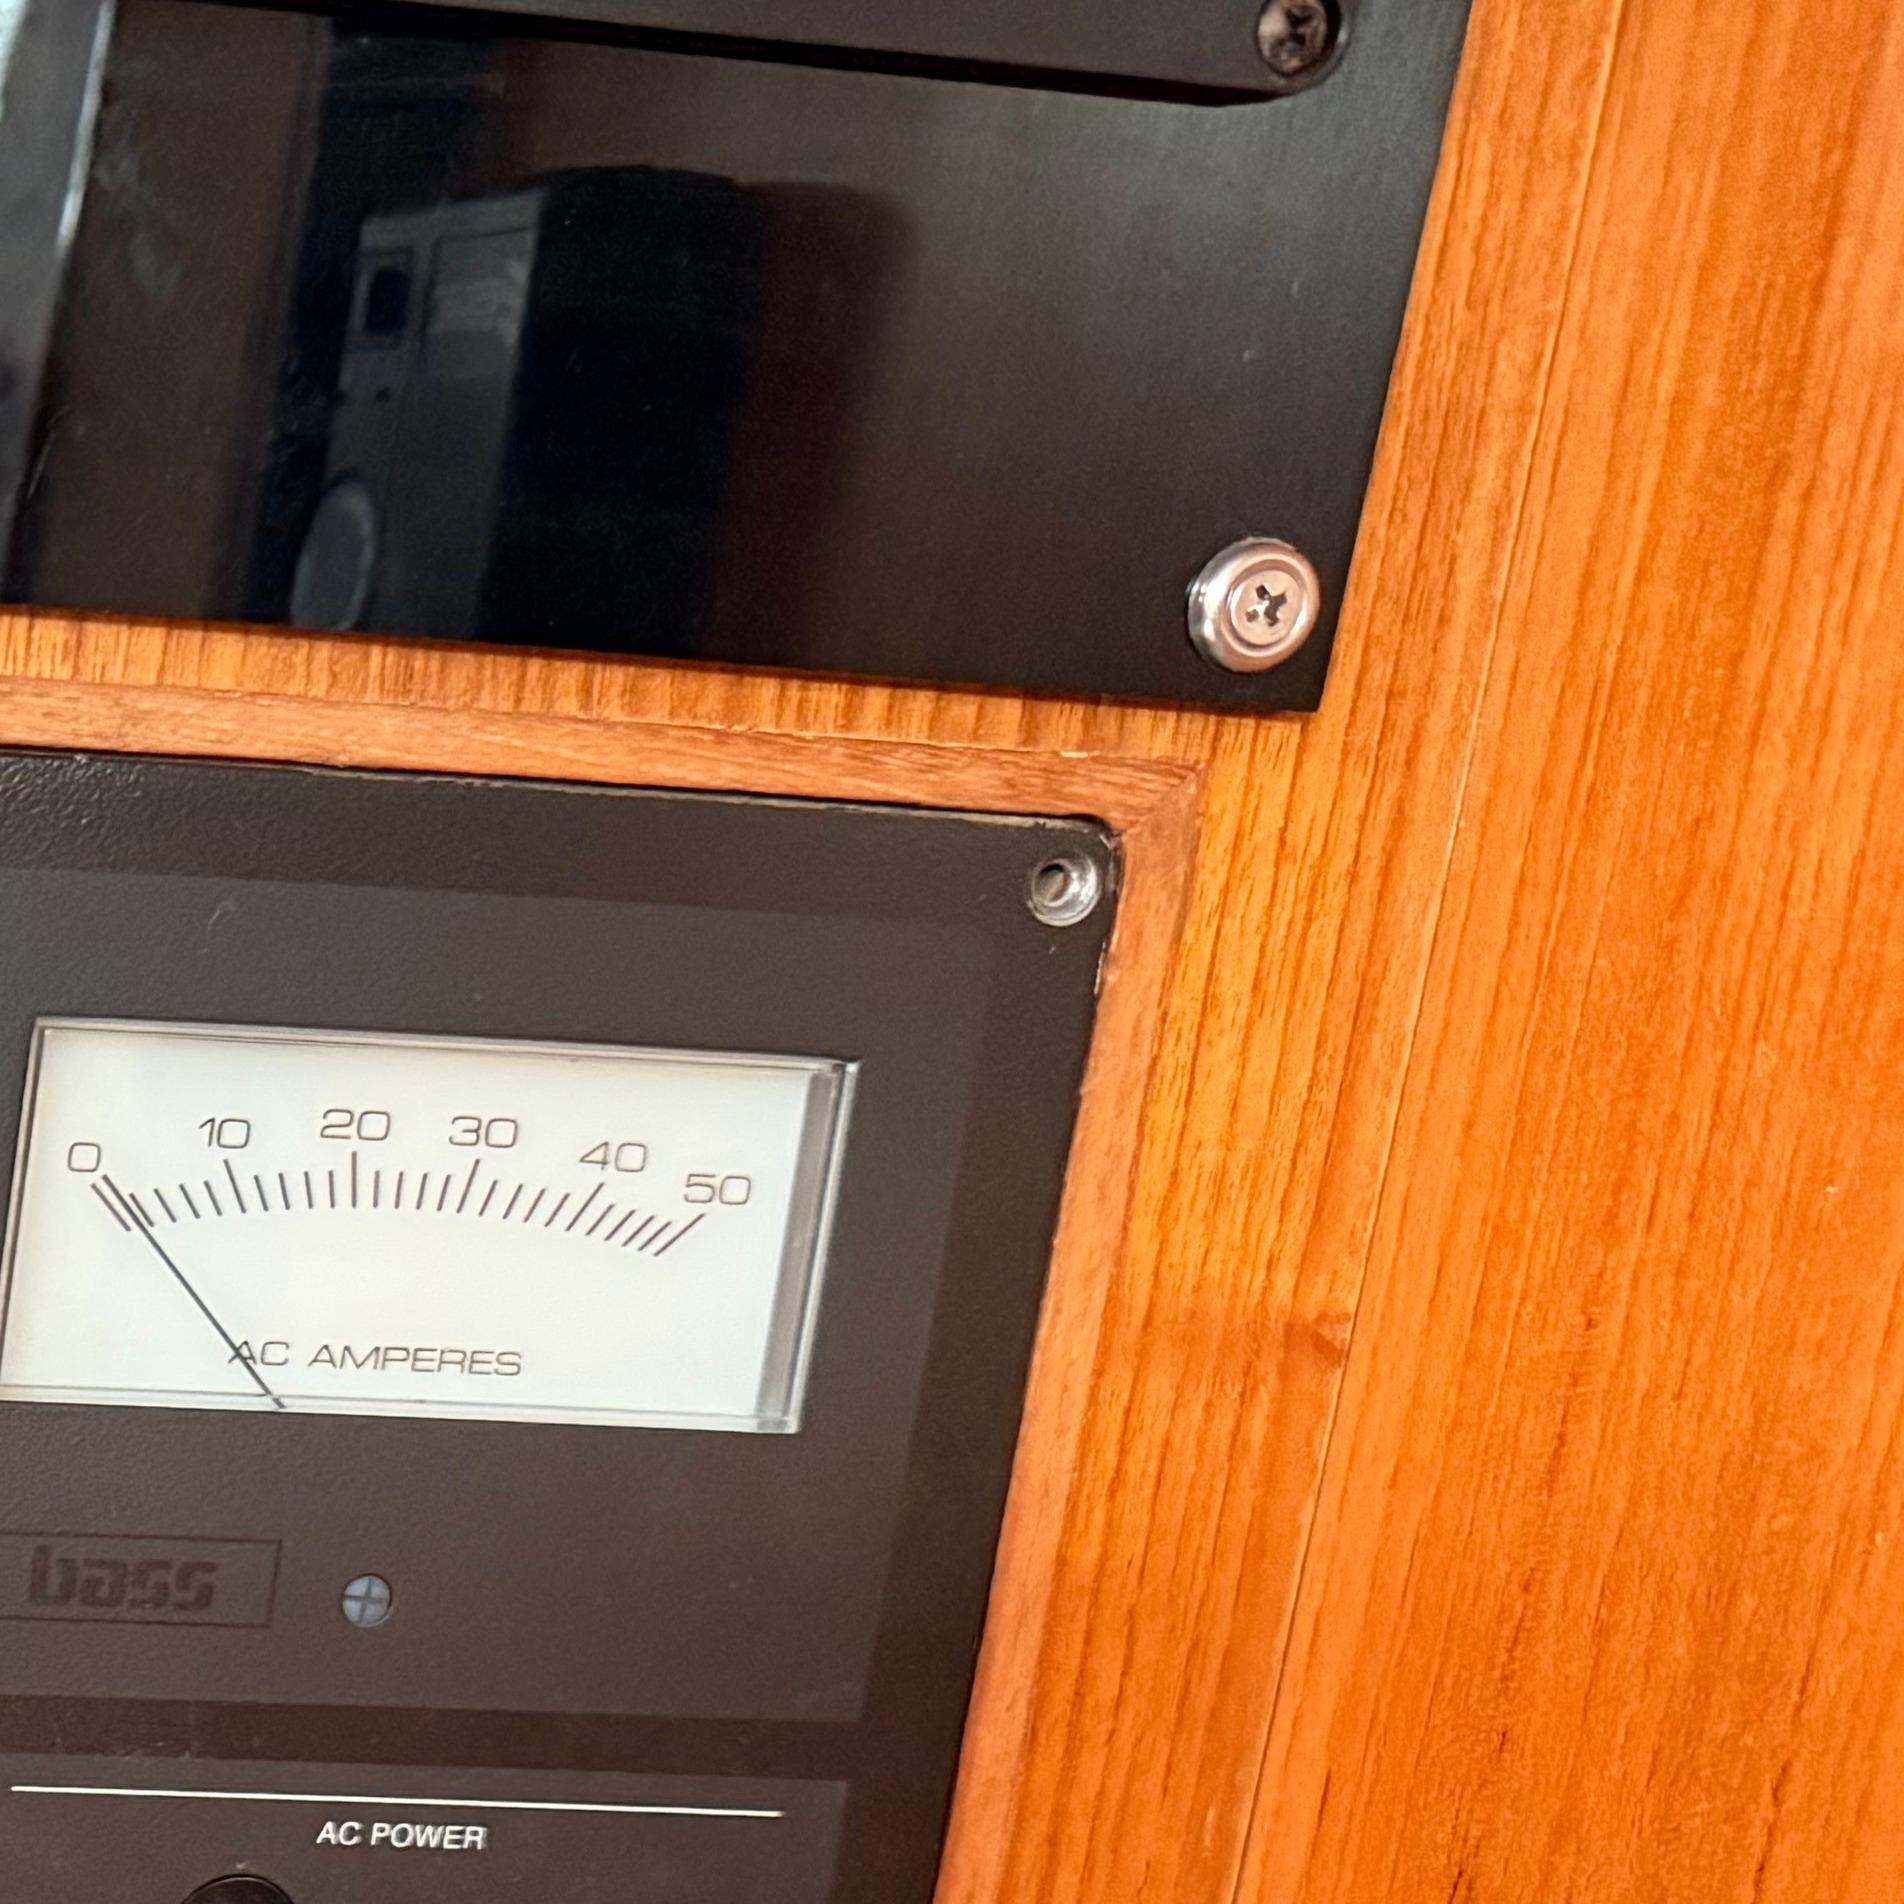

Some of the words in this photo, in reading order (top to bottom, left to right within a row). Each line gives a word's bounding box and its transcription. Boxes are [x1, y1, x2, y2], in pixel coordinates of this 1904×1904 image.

[198, 1117, 251, 1149] 10
[320, 1108, 390, 1141] 20
[448, 1117, 519, 1149] 30
[579, 1142, 647, 1174] 40
[683, 1174, 751, 1206] 50
[228, 1340, 290, 1367] AC
[307, 1345, 522, 1376] AMPERES
[316, 1822, 362, 1847] AC
[370, 1823, 488, 1851] POWER
